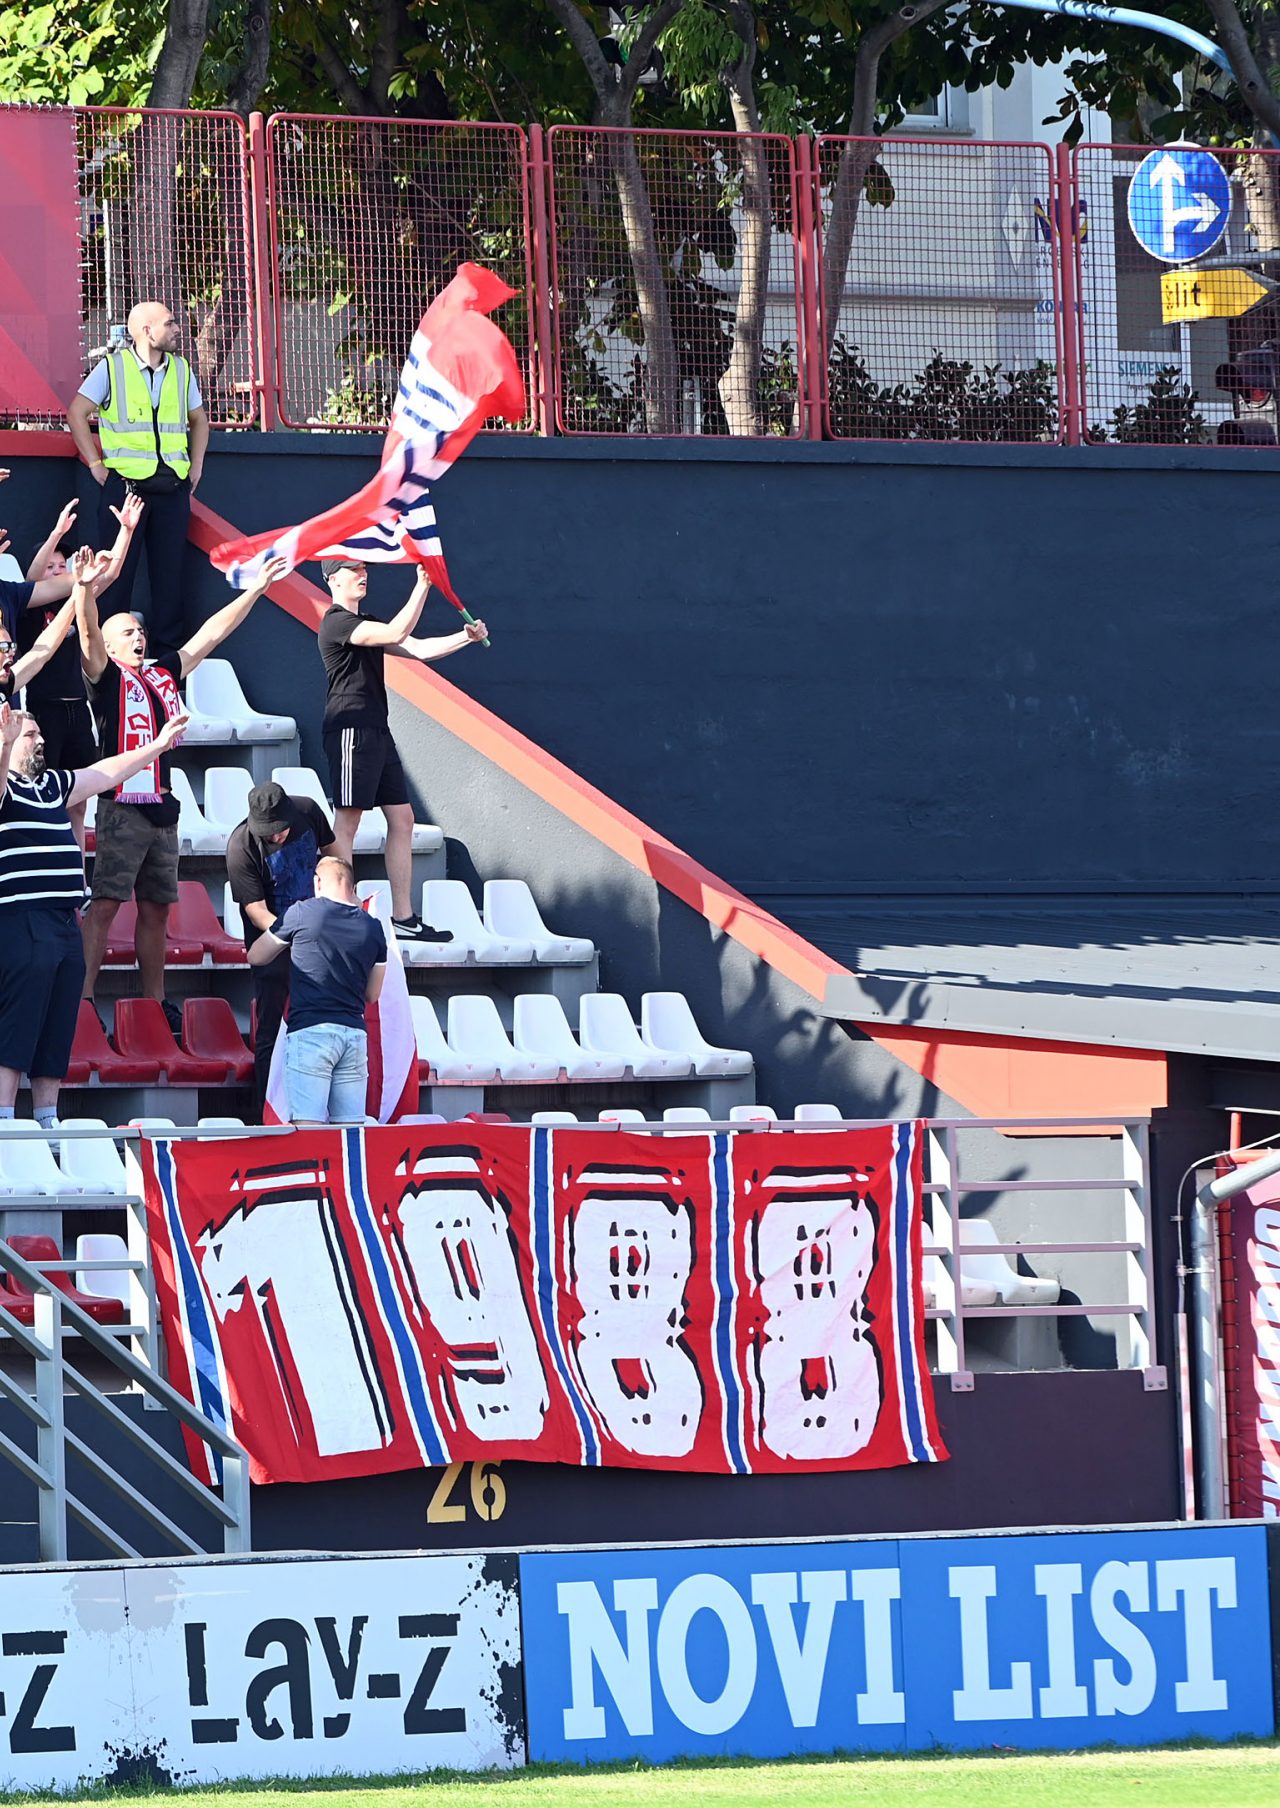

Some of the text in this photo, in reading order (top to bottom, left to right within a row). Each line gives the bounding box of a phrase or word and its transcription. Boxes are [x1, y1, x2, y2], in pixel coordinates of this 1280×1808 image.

[1118, 361, 1170, 376] SIEMEN
[197, 1144, 881, 1459] 1988
[427, 1461, 507, 1523] 26
[556, 1556, 1238, 1740] NOVI LIST
